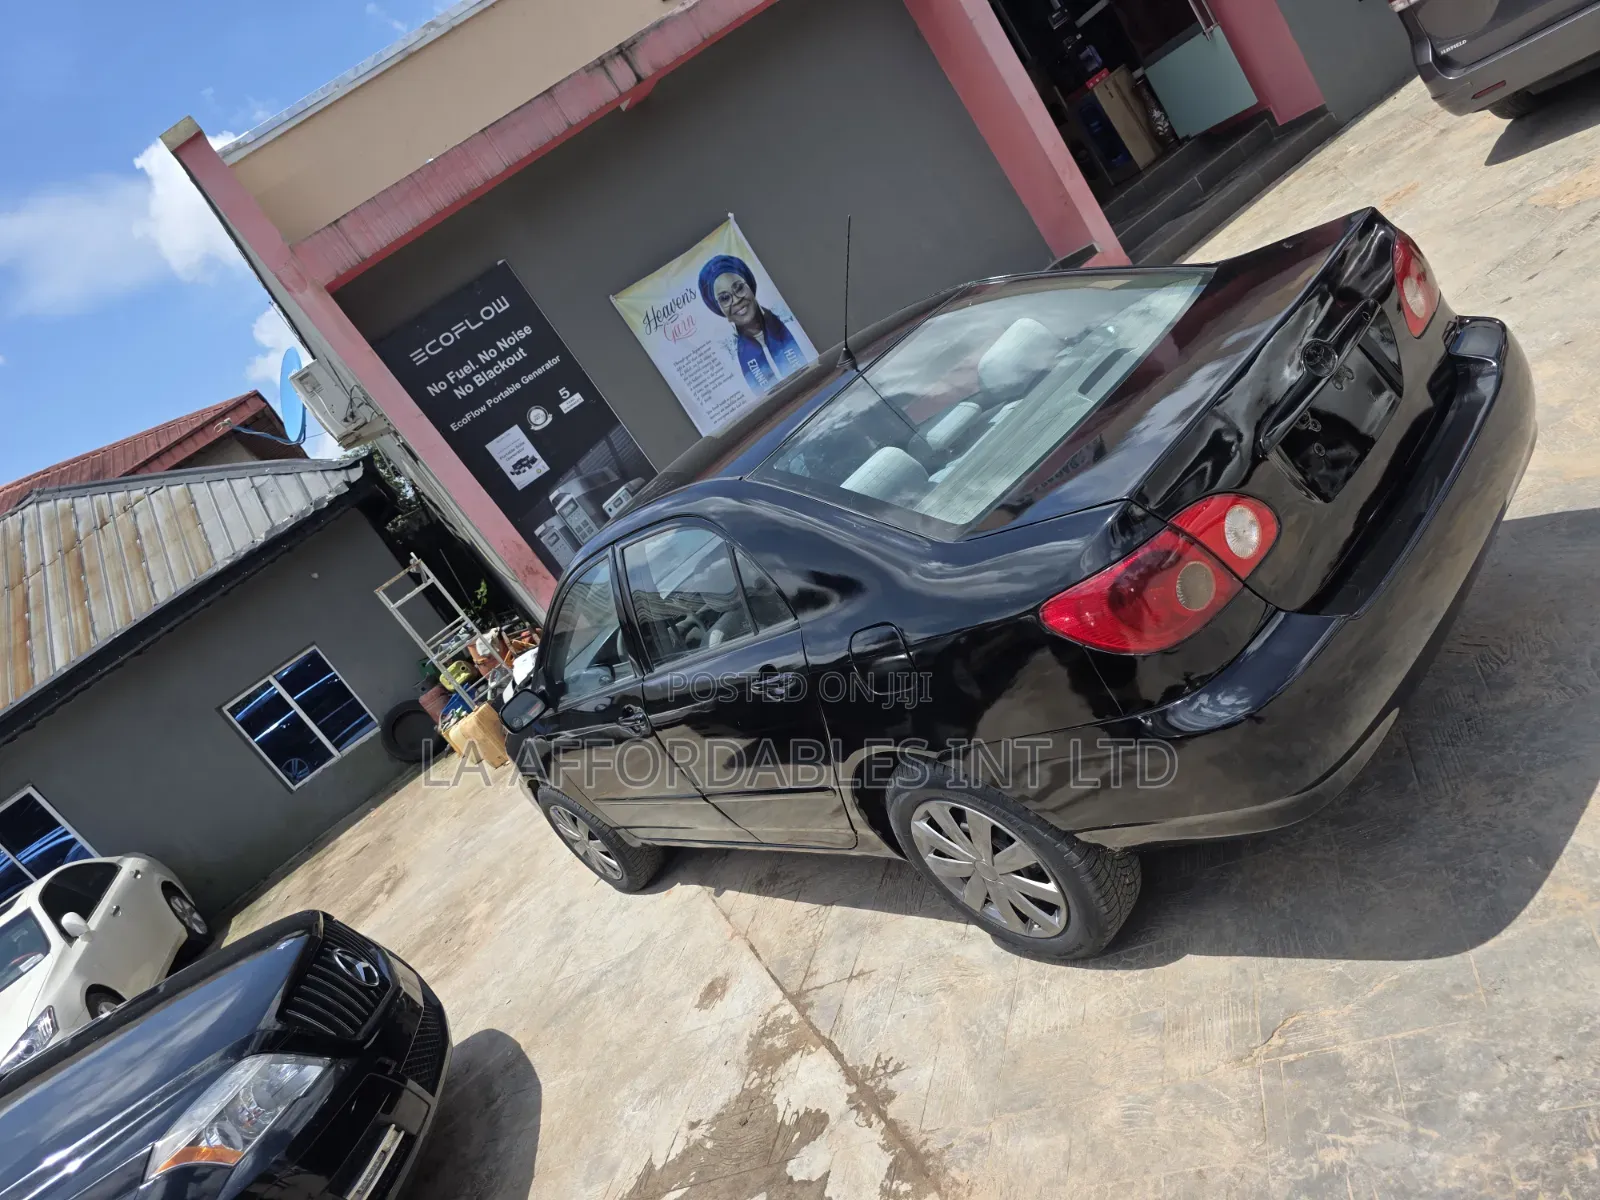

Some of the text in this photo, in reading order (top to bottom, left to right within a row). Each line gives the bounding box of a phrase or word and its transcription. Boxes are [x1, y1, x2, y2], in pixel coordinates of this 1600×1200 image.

[409, 296, 510, 366] ECOFLOW
[642, 288, 697, 336] Heaven's
[426, 325, 532, 397] No Fuel. No Noise
[453, 347, 528, 400] No Blackout
[747, 358, 769, 387] EZINNE
[449, 355, 561, 432] EcoFlow Portable Generator
[558, 386, 570, 399] 5
